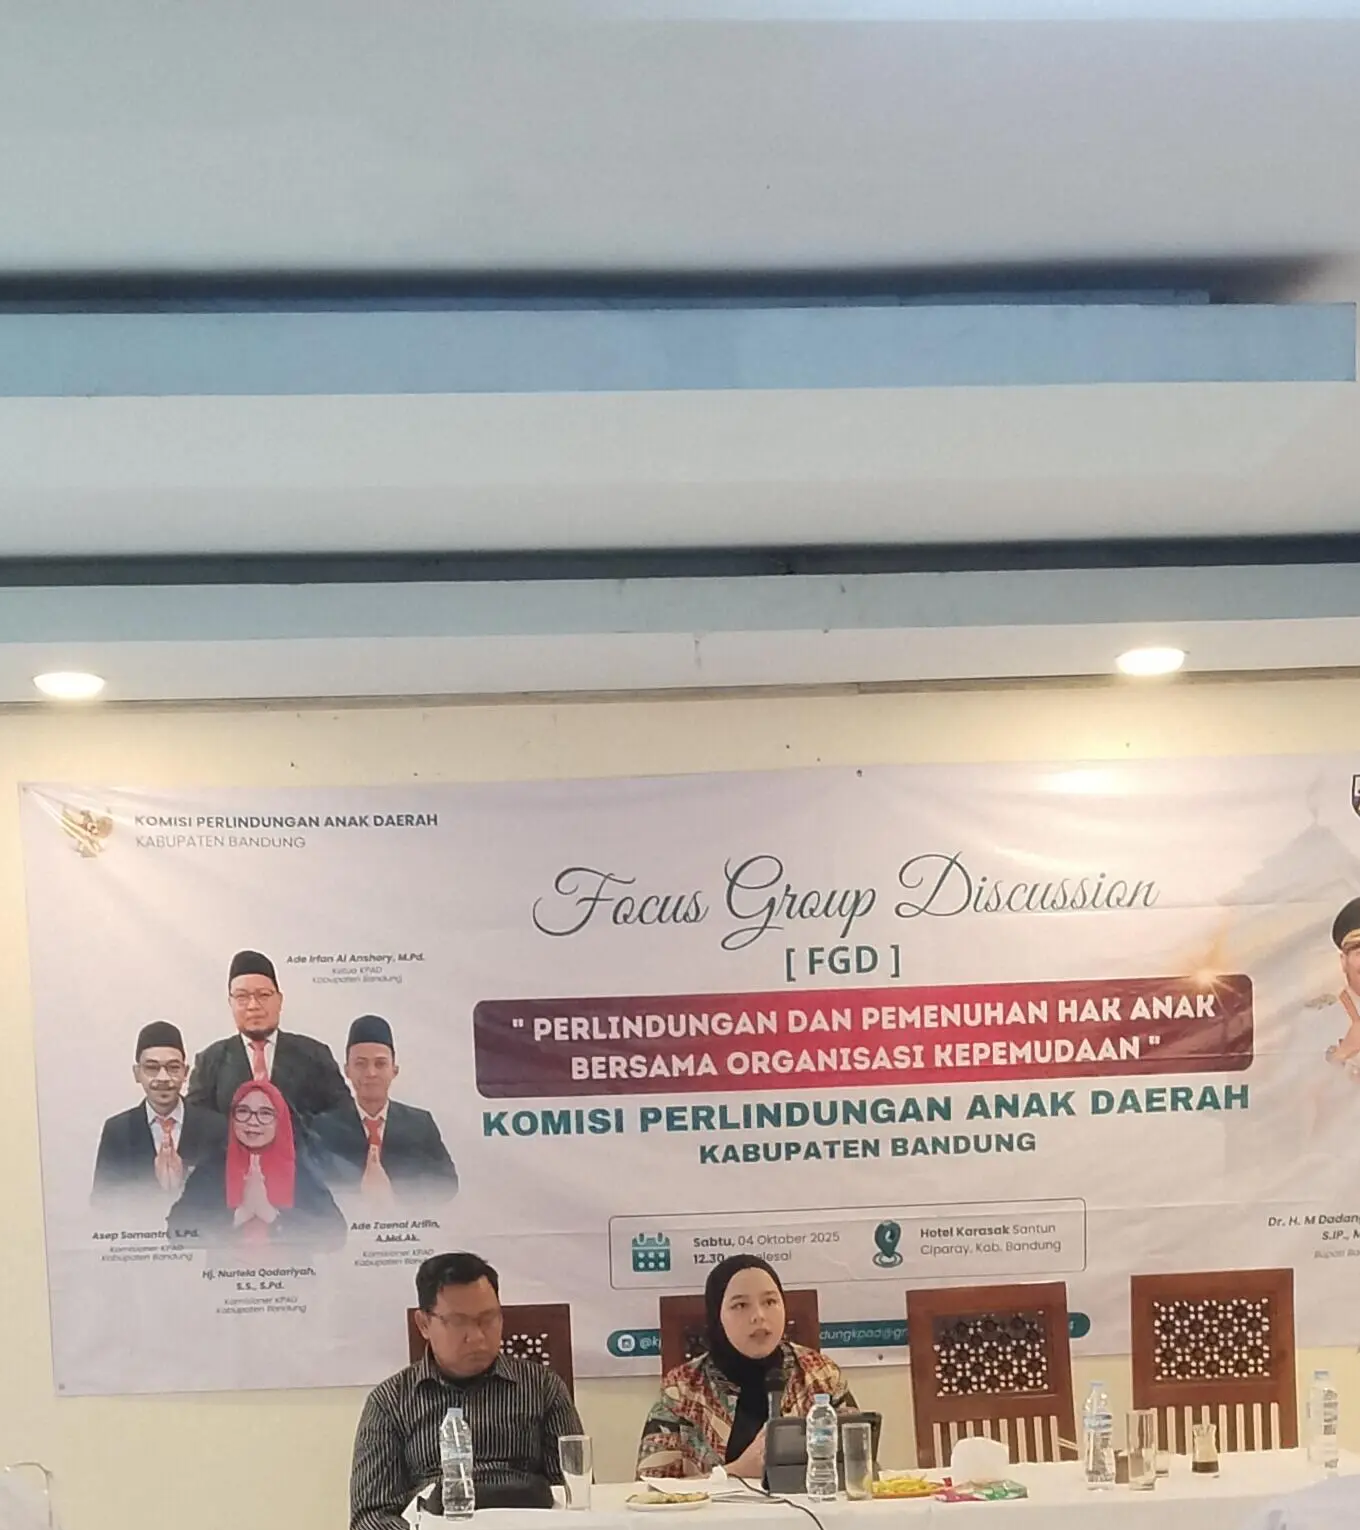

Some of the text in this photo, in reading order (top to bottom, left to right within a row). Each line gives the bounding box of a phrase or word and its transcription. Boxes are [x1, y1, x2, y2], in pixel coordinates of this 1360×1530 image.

[134, 813, 439, 829] KOMISI PERLINDUNGAN ANAK DAERAH
[135, 835, 306, 849] KABUPATEN BANDUNG
[532, 850, 1161, 951] Focus Group Discussion
[286, 954, 307, 964] Ade
[309, 954, 334, 964] Irfan
[807, 944, 879, 976] FGD
[533, 1009, 778, 1042] PERLINDUNGAN
[787, 1007, 853, 1034] DAN
[861, 999, 1049, 1031] PEMENUHAN
[1057, 996, 1122, 1023] HAK
[1129, 993, 1217, 1021] ANAK
[571, 1053, 719, 1082] BERSAMA
[726, 1043, 926, 1076] ORGANISASI
[933, 1035, 1141, 1068] KEPEMUDAAN
[481, 1084, 1250, 1137] KOMISI PERLINDUNGAN ANAK DAERAH
[699, 1132, 1037, 1165] KABUPATEN BANDUNG
[1267, 1216, 1286, 1227] Dr.
[1289, 1215, 1301, 1226] H.
[1304, 1215, 1316, 1225] M
[919, 1223, 1056, 1239] Hotel Karasak Santun
[693, 1231, 841, 1248] Sabtu, 04 Oktober 2025
[975, 1241, 1002, 1253] Kab.
[1005, 1239, 1062, 1254] Bandung
[692, 1253, 725, 1265] 12.30
